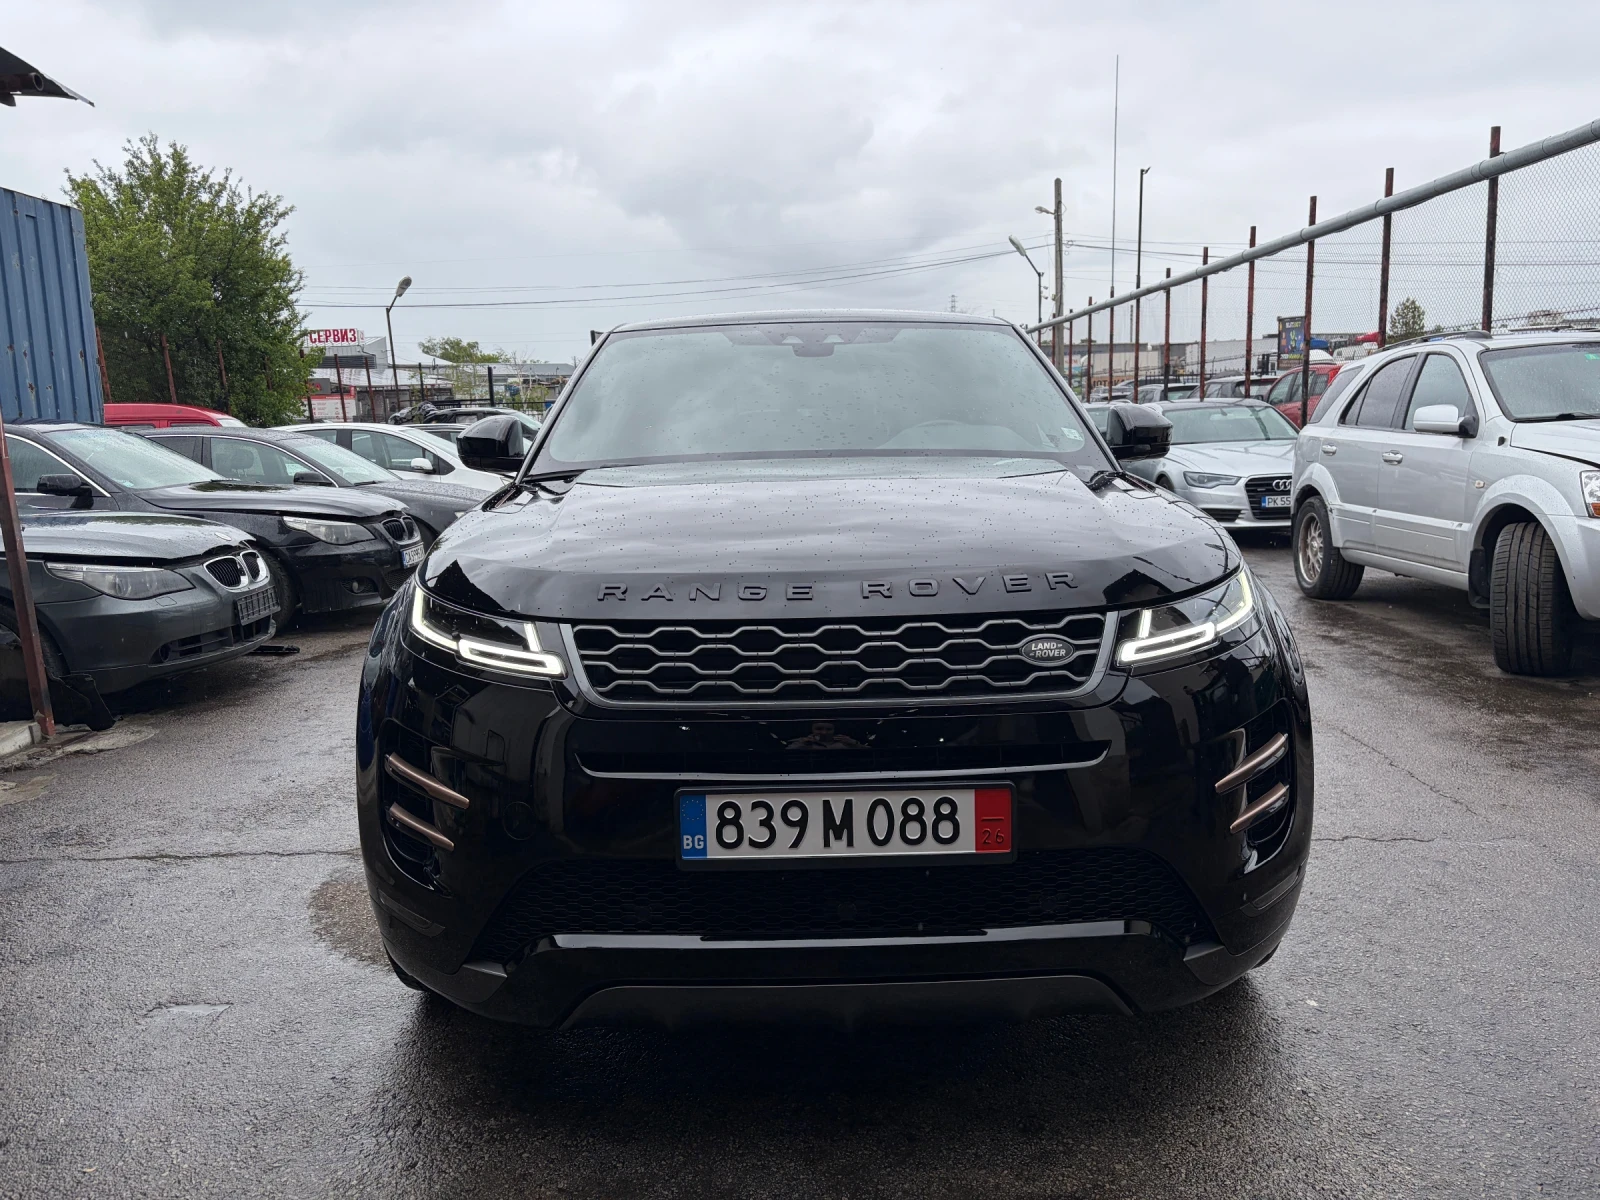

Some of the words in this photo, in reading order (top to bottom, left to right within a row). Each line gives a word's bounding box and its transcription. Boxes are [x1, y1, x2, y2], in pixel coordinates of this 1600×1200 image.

[309, 328, 357, 343] СЕРВИЗ
[1267, 497, 1279, 506] PK
[597, 582, 813, 602] RANGE
[861, 571, 1078, 600] ROVER
[1031, 642, 1057, 651] LAND
[1035, 649, 1067, 658] ROVER
[715, 798, 810, 850] 839
[822, 797, 855, 848] M
[866, 795, 961, 847] 088
[682, 834, 705, 850] BG
[981, 827, 1005, 845] 26
